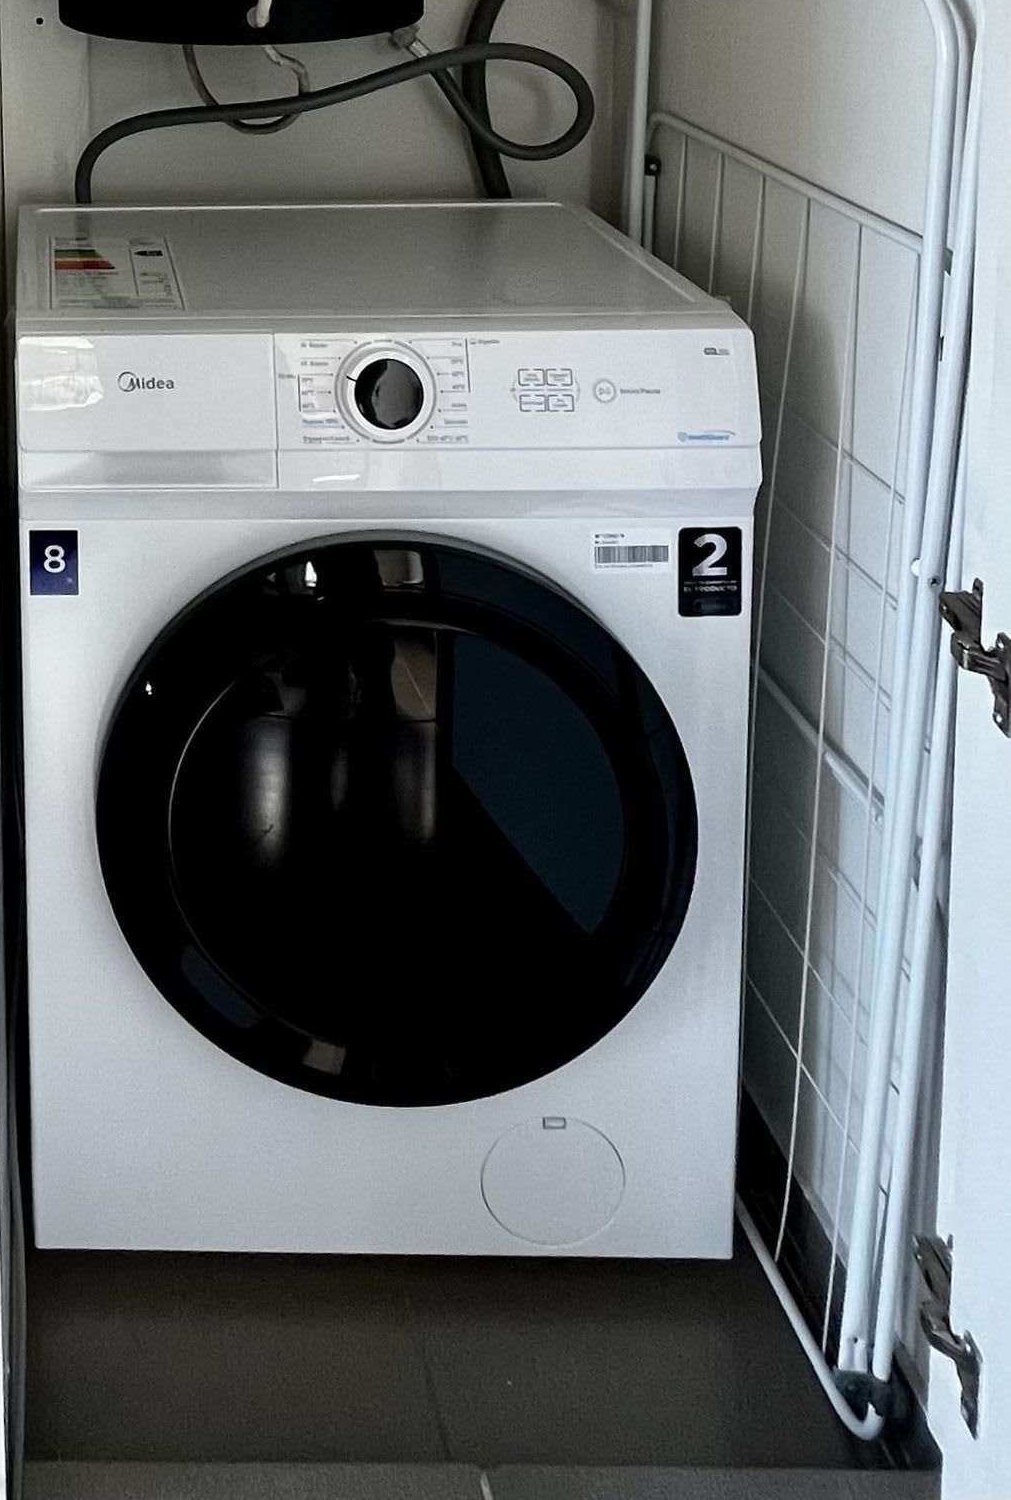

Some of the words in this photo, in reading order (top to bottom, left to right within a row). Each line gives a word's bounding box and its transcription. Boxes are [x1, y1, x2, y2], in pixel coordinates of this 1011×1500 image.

[118, 371, 175, 393] Midea
[43, 544, 66, 573] 8
[692, 533, 728, 577] 2
